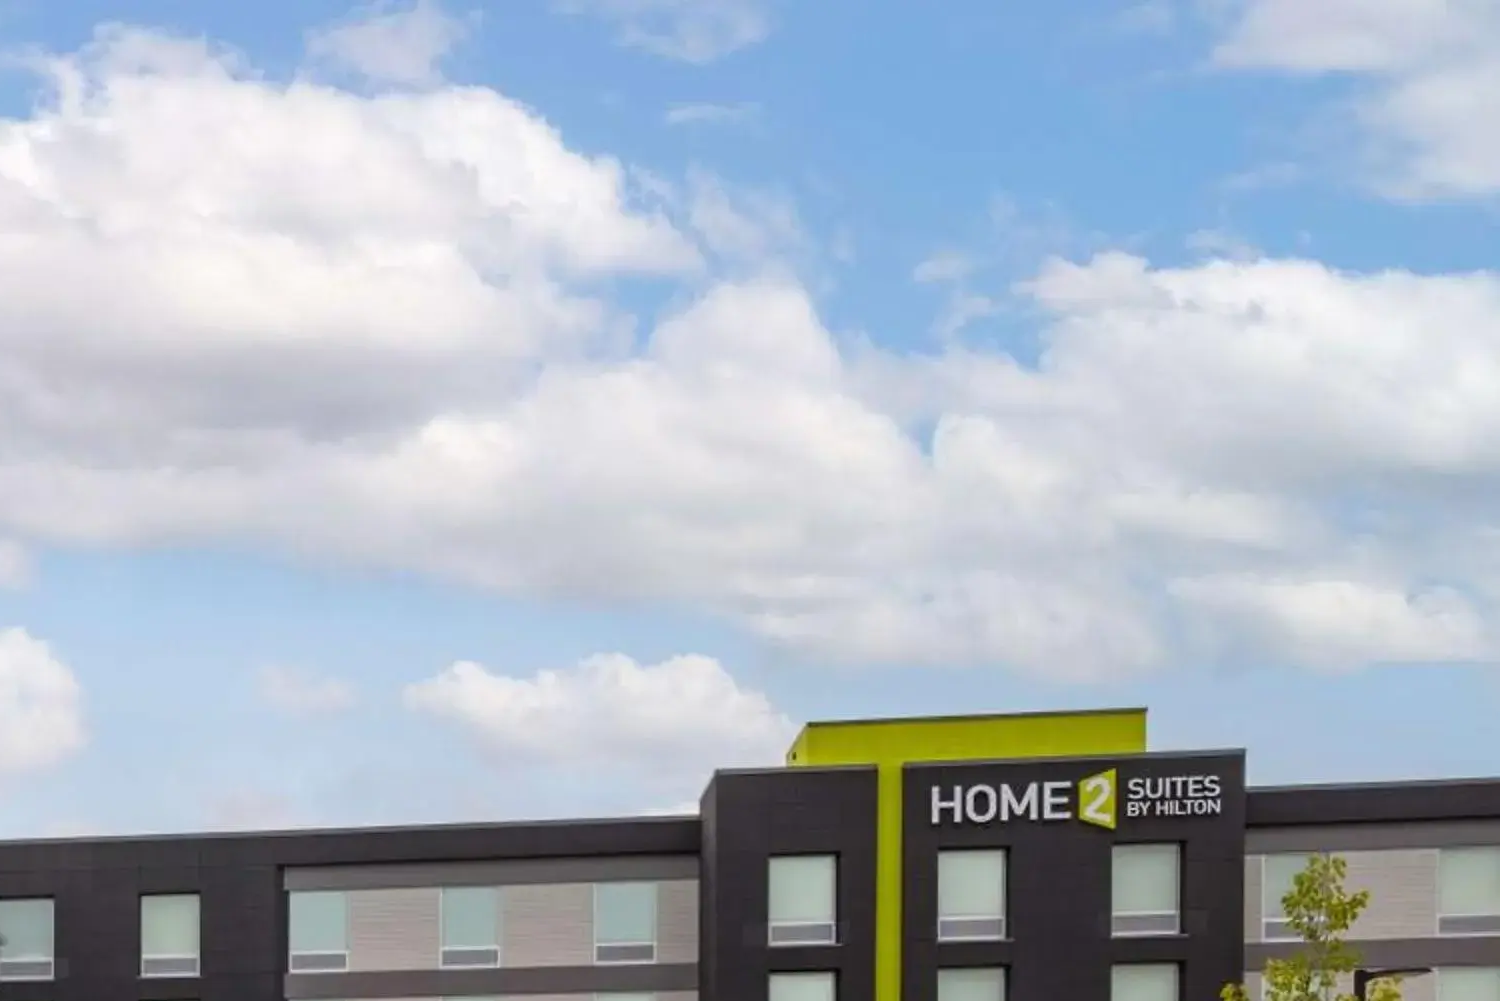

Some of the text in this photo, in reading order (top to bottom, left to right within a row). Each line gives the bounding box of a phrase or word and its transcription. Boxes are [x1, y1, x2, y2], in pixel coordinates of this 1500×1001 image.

[1127, 775, 1221, 799] SUITES
[930, 777, 1112, 824] HOME 2
[1127, 798, 1221, 817] BY HILTON
